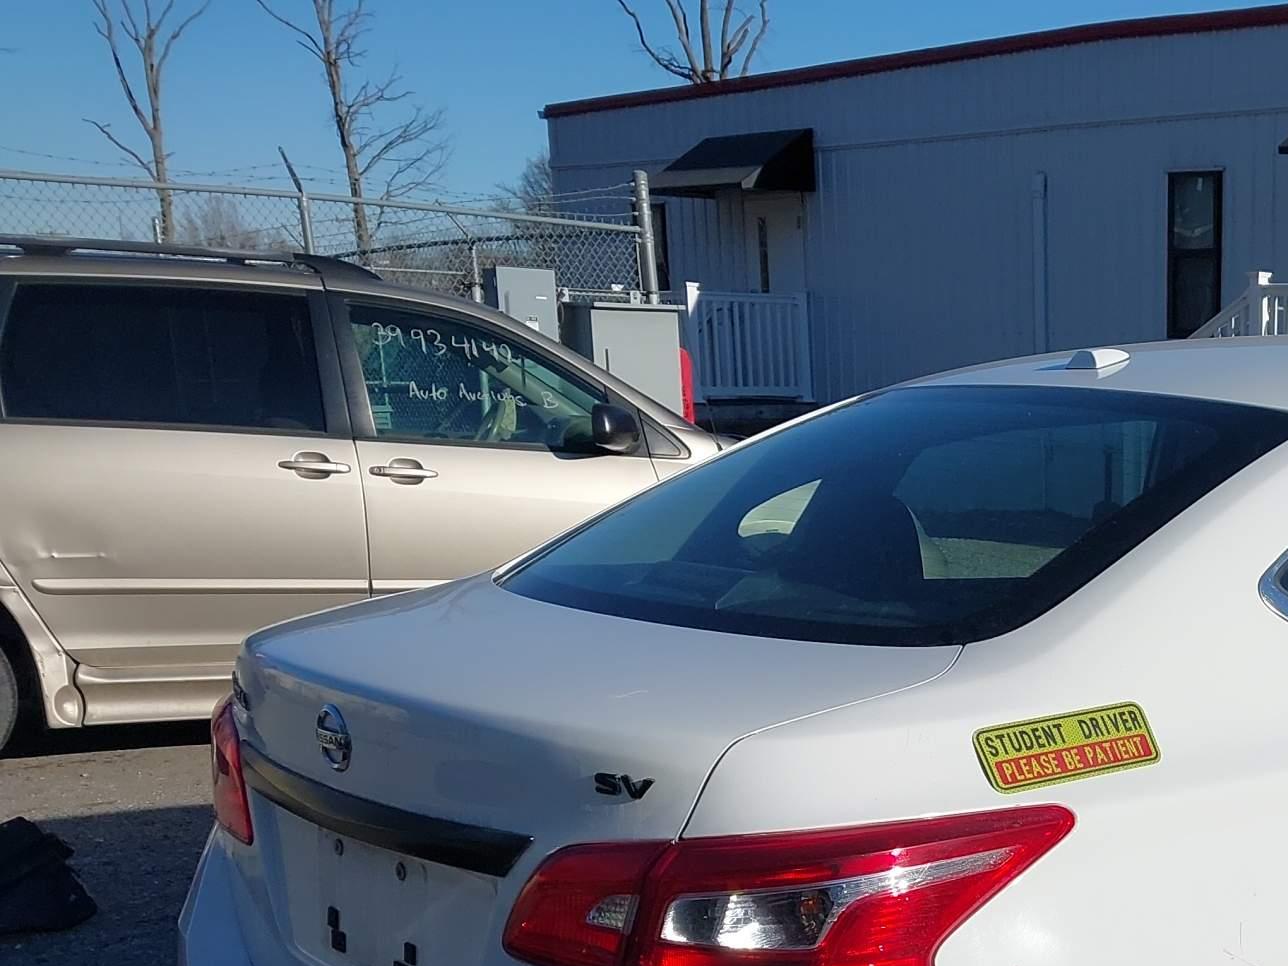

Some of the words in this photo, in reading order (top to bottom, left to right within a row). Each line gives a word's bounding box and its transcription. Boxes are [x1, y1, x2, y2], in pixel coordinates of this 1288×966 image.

[409, 380, 449, 400] Auto
[985, 723, 1067, 757] STUDENT
[1078, 711, 1142, 739] DRIVER
[1003, 753, 1062, 782] PLEASE
[1063, 748, 1084, 770] BE
[1086, 738, 1145, 766] PATIENT
[594, 772, 656, 800] SV
